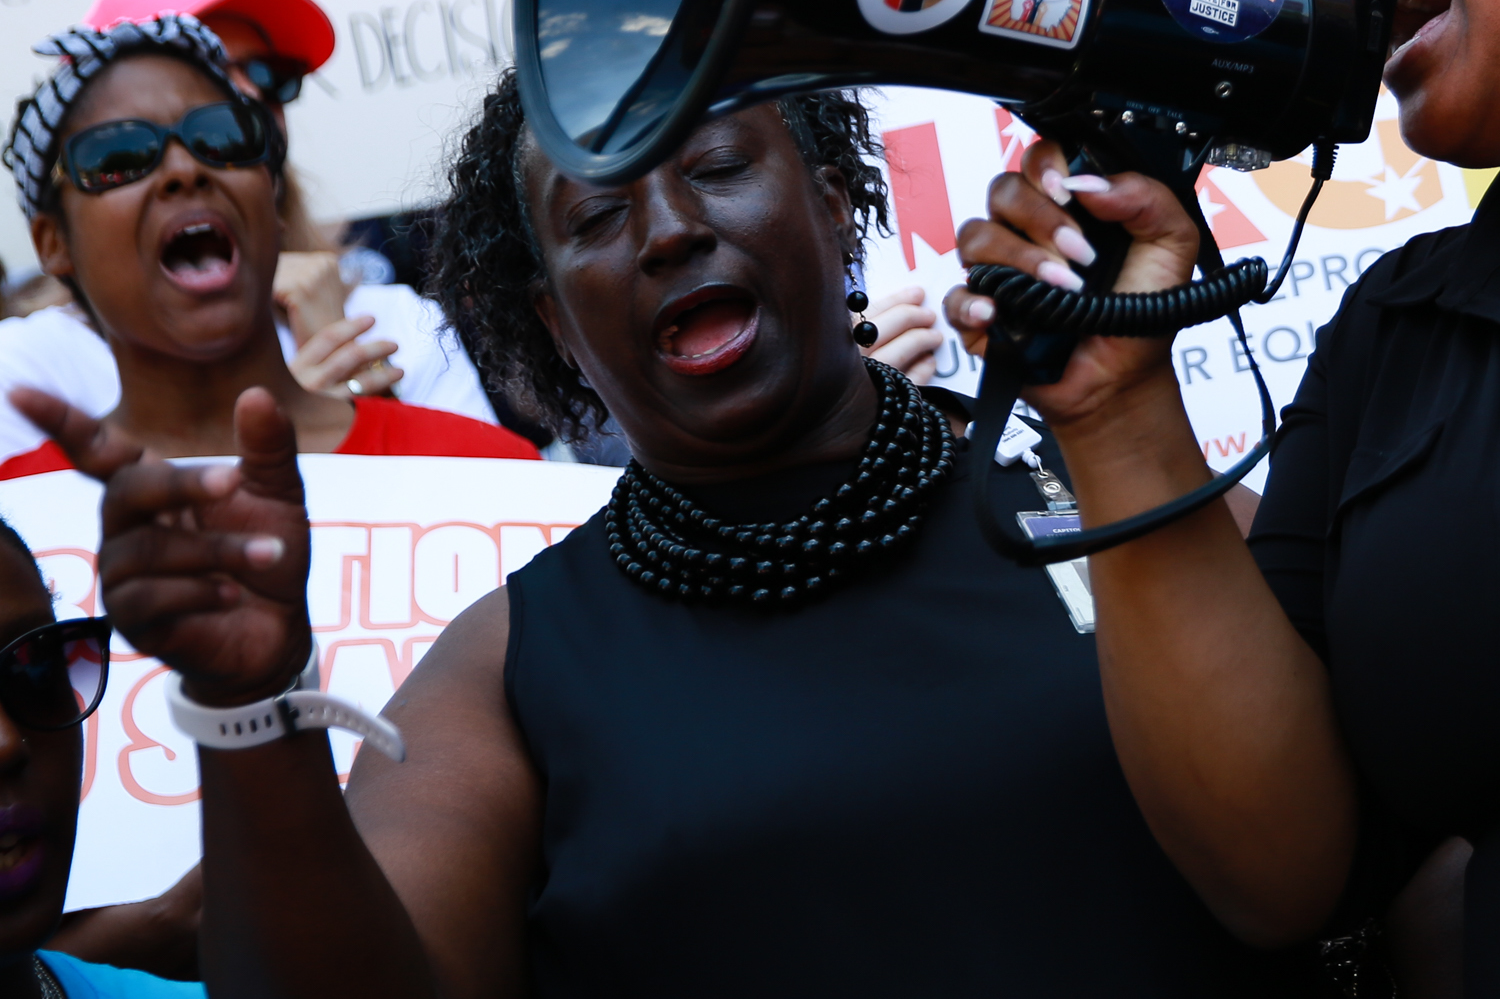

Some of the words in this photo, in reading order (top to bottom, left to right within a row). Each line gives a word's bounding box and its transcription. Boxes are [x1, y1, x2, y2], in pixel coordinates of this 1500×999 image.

[1191, 2, 1236, 25] JUSTICE
[1211, 58, 1255, 74] AUX/MP3
[1148, 106, 1161, 115] OFF
[1166, 110, 1184, 120] TALK
